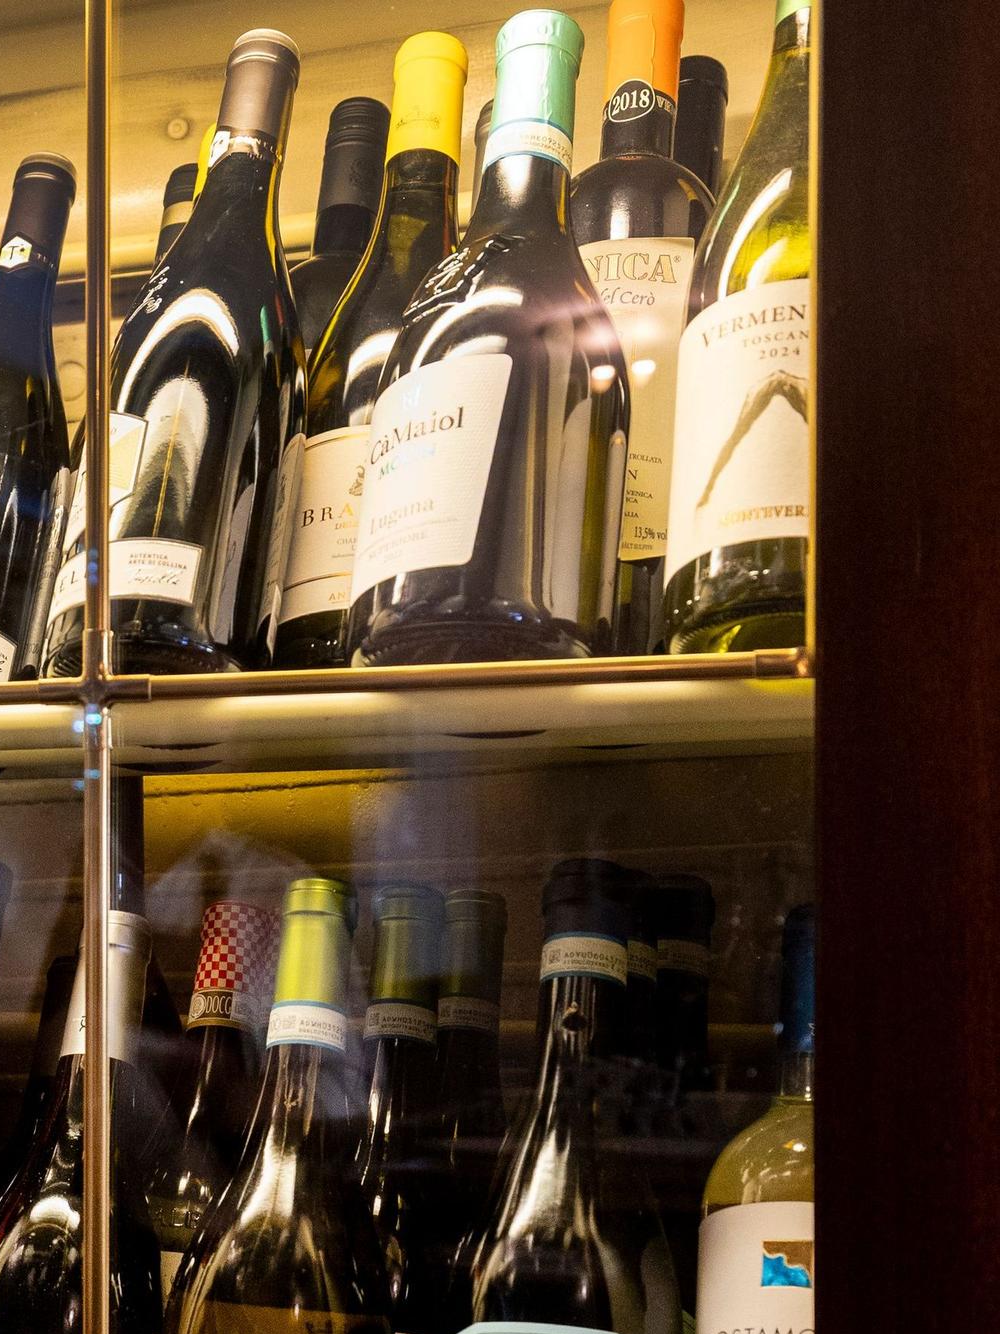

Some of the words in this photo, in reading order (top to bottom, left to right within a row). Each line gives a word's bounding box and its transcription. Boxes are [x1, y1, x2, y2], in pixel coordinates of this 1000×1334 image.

[611, 88, 650, 113] 2018
[585, 252, 677, 284] NICA
[701, 304, 808, 348] VERMEN
[742, 330, 809, 348] TOSCAN
[758, 347, 801, 360] 2024
